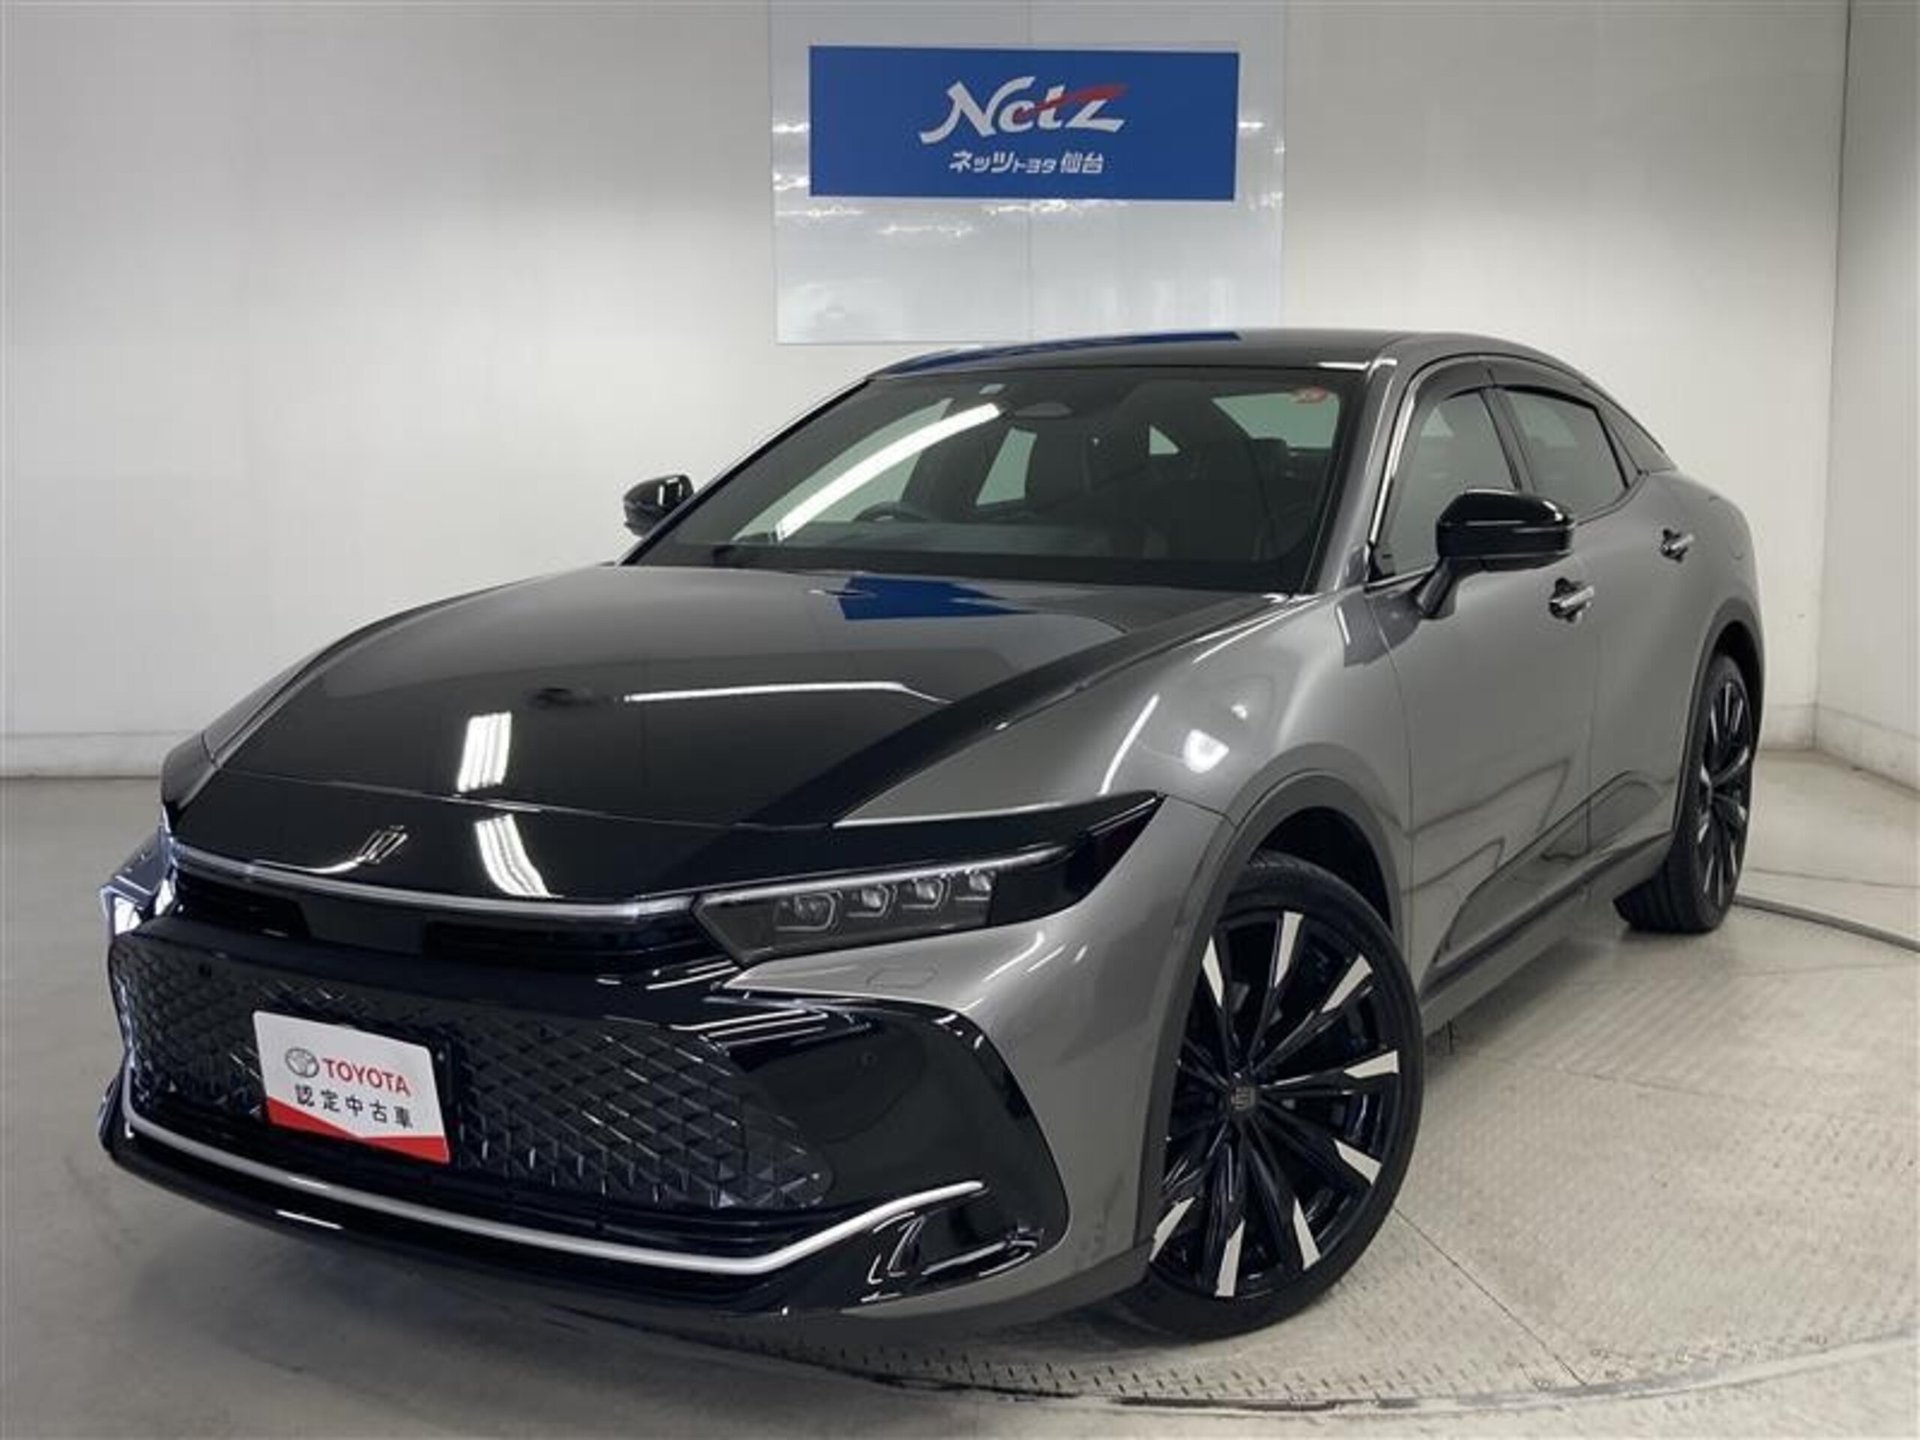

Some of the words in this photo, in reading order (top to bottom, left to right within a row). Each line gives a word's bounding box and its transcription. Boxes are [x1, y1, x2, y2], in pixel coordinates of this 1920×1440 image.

[919, 75, 1128, 144] Netz
[322, 1057, 411, 1097] TOYOTA
[294, 1083, 413, 1129] 認定中古車
